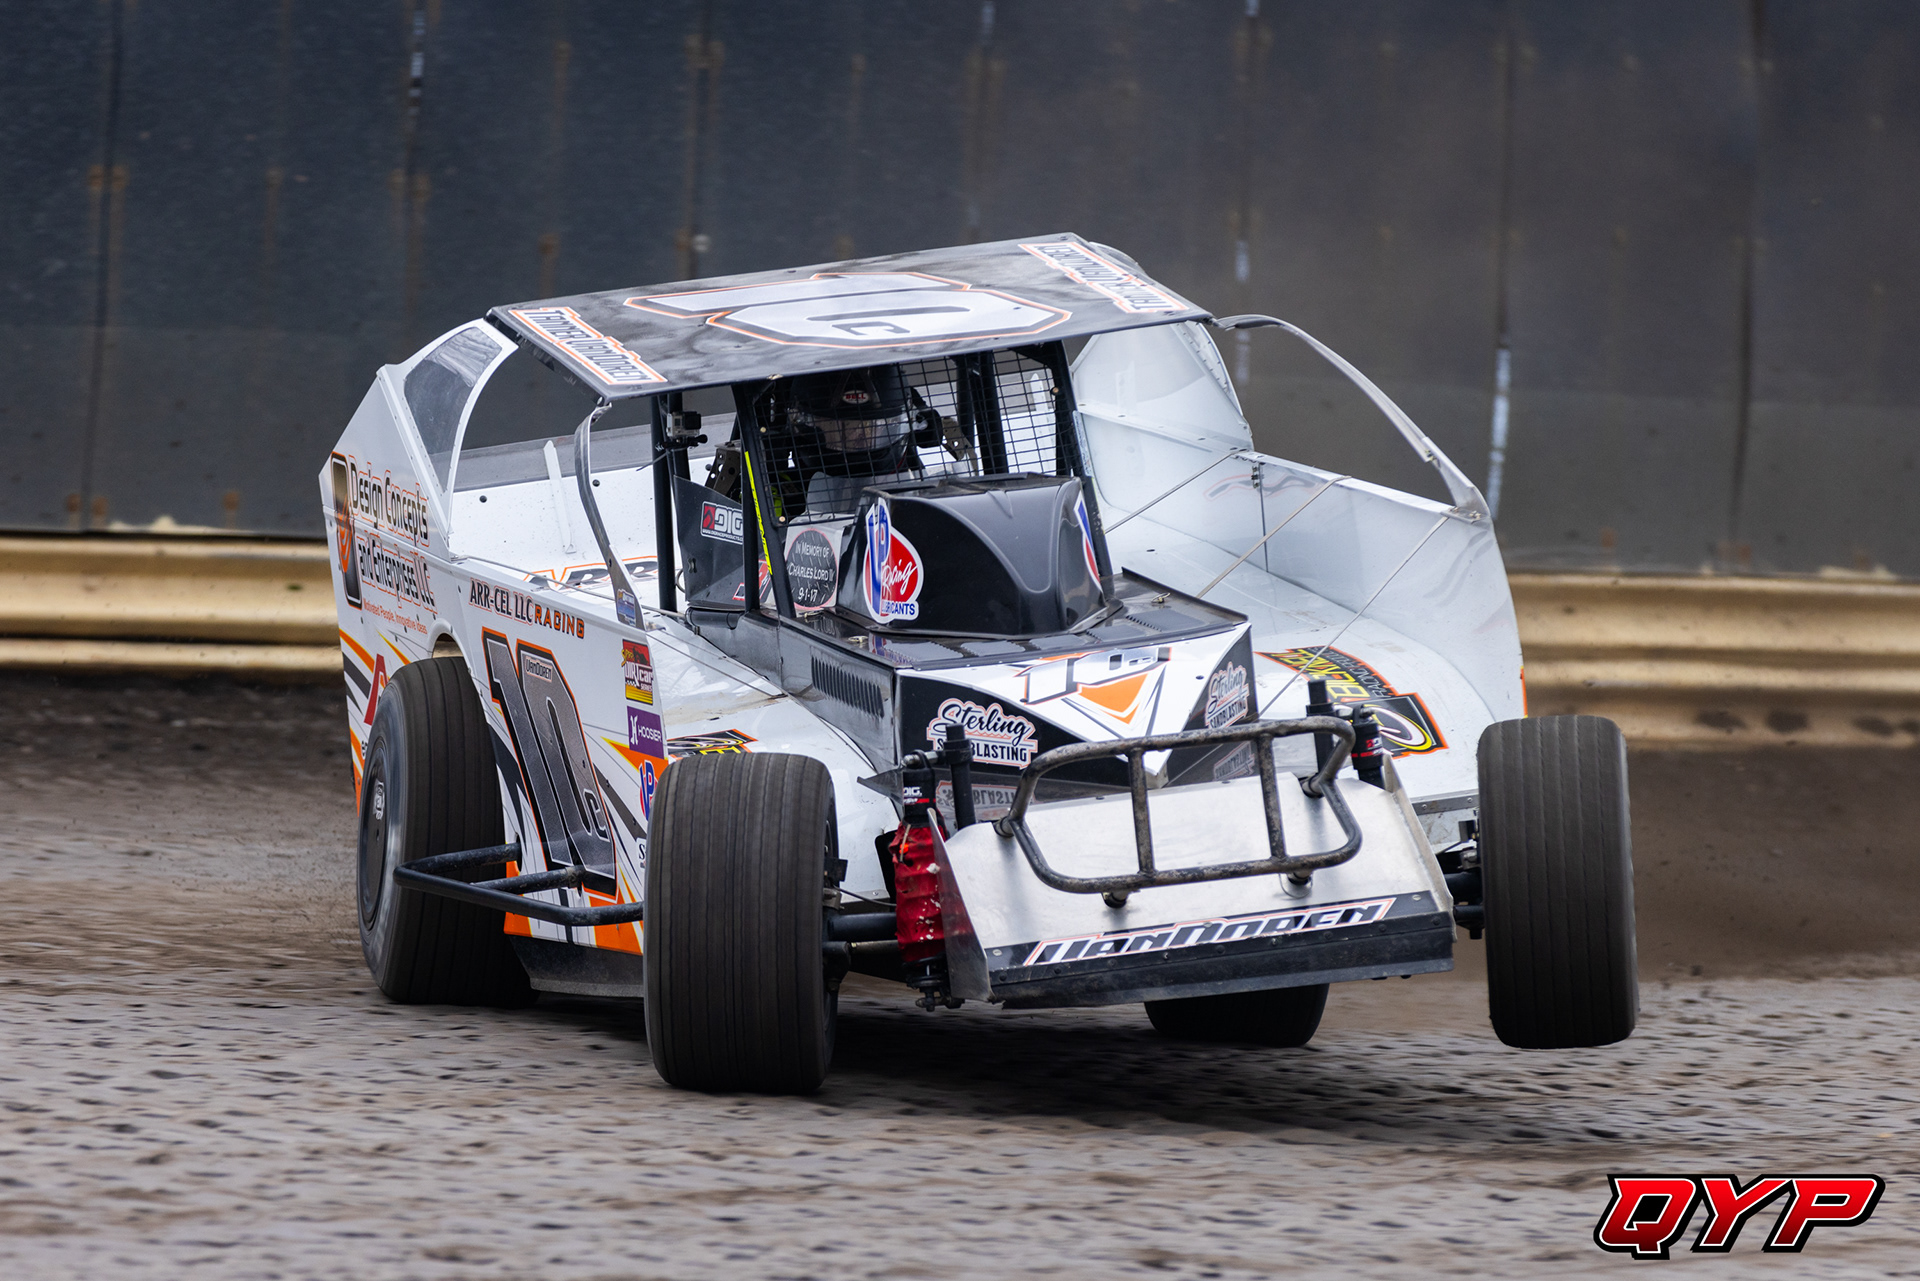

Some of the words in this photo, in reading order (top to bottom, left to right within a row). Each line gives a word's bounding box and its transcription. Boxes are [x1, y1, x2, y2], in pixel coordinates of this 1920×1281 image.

[350, 462, 383, 529] Design
[384, 476, 428, 547] Concepts
[802, 541, 823, 557] MEMORY
[373, 539, 419, 602] Enterprises
[413, 555, 436, 607] LLC
[788, 562, 813, 578] CHARLES
[813, 563, 829, 581] LORD
[882, 559, 918, 596] Racing
[470, 580, 512, 616] ARR-CEL
[514, 593, 534, 623] LLC
[534, 603, 585, 639] RACING
[1208, 667, 1243, 714] Sterling
[638, 724, 662, 742] HOOSIER
[932, 703, 1031, 747] Sterling
[936, 737, 1028, 763] SBLASTING
